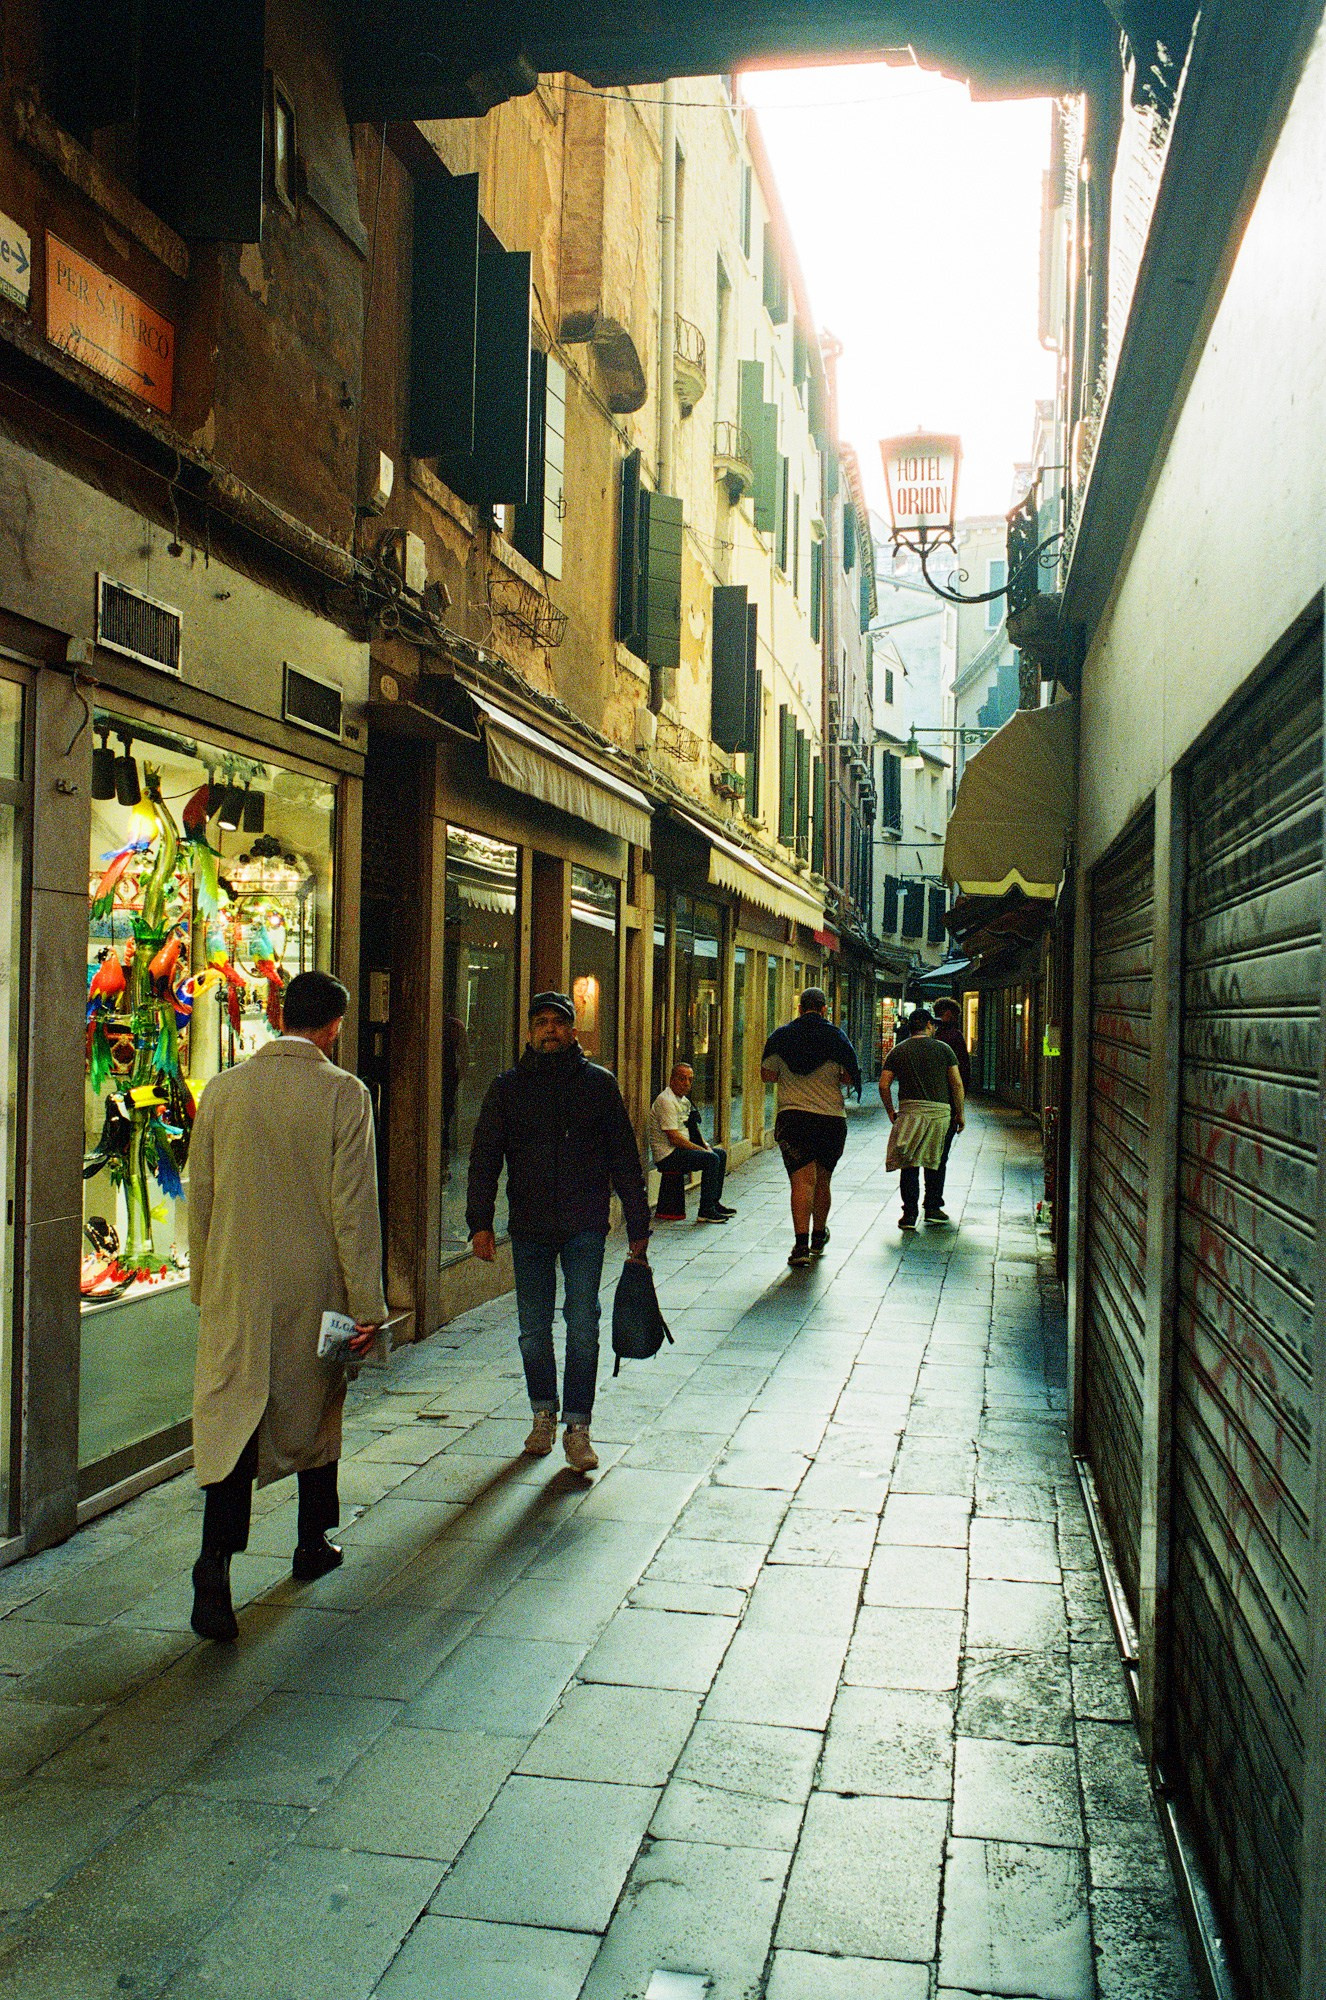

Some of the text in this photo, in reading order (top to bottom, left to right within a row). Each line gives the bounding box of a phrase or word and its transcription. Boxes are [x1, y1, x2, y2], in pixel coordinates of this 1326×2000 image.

[57, 259, 90, 306] PER
[110, 297, 169, 359] MARCO
[897, 456, 945, 482] HOTEL
[897, 486, 948, 516] ORION
